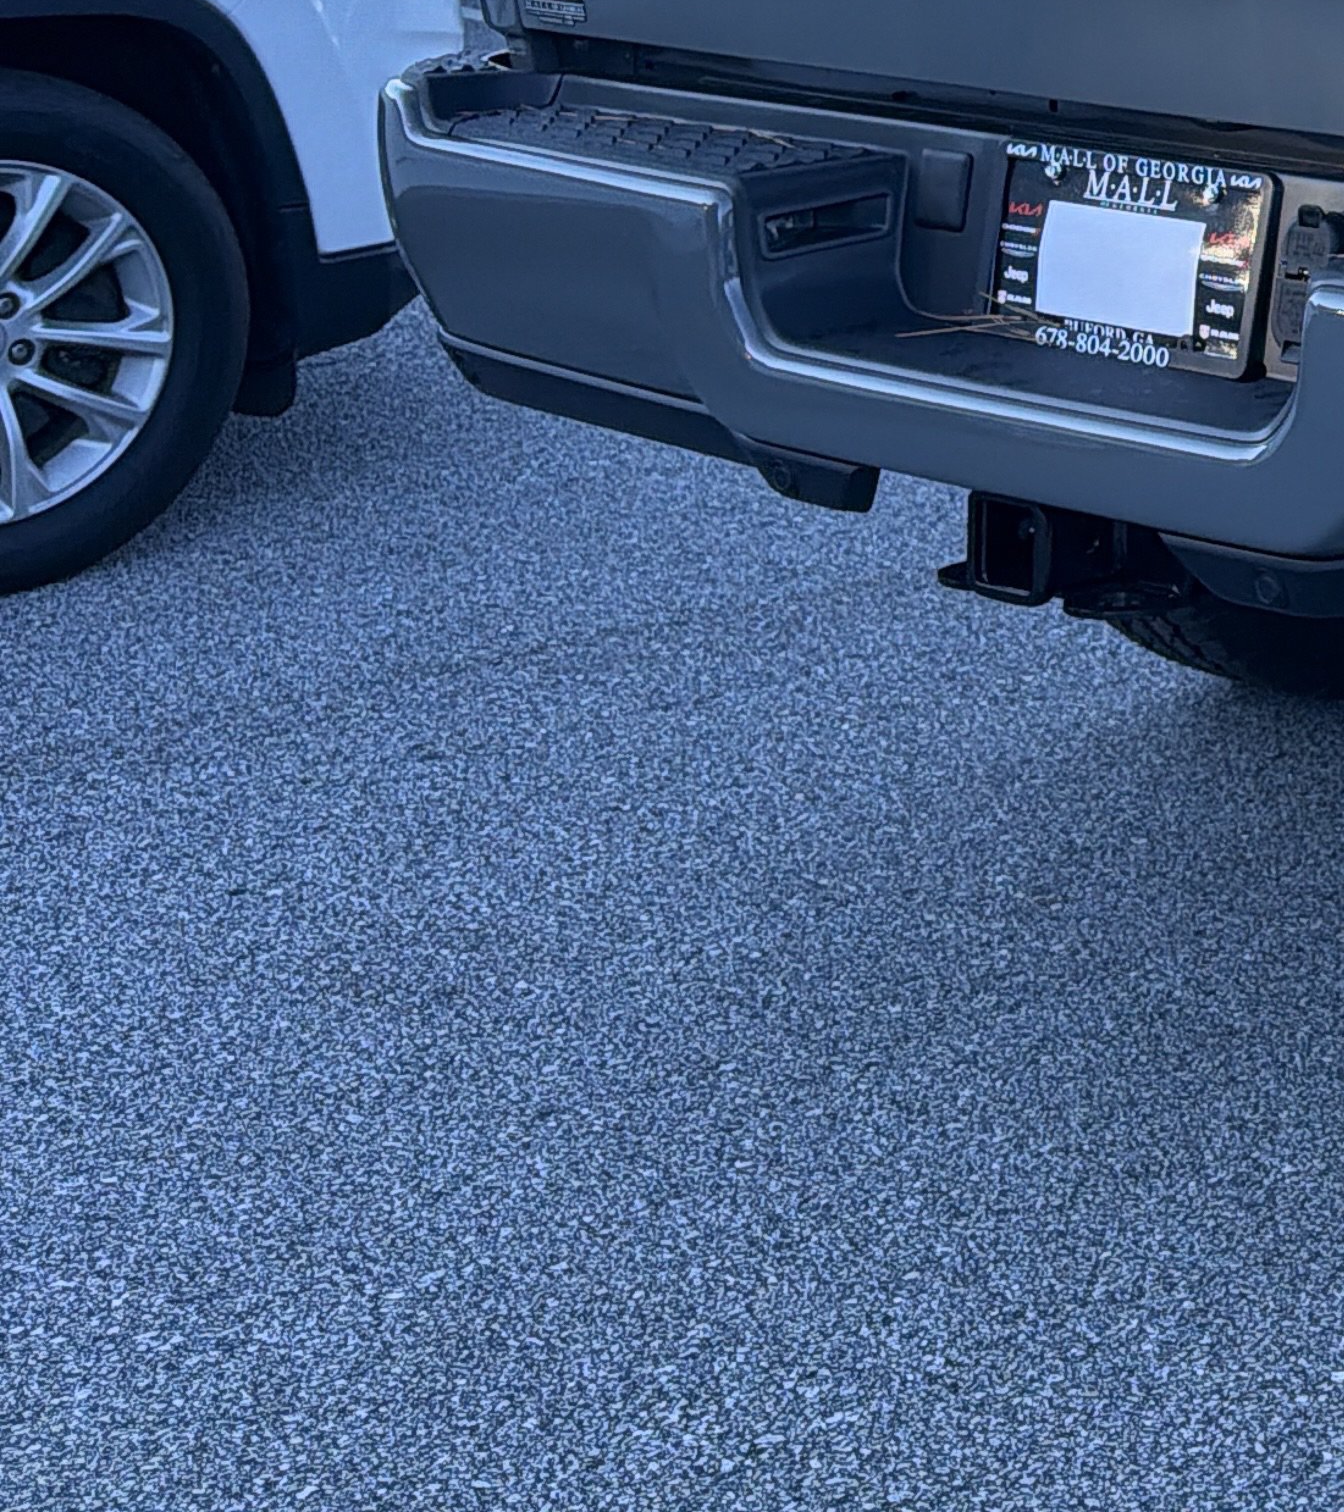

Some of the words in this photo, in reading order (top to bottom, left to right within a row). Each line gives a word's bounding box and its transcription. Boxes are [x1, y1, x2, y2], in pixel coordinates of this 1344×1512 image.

[1103, 153, 1128, 174] OF
[1135, 157, 1225, 187] GEORGIA
[1003, 265, 1029, 283] Jeep
[1206, 299, 1235, 319] Jeep
[1035, 326, 1169, 368] 678-804-2000
